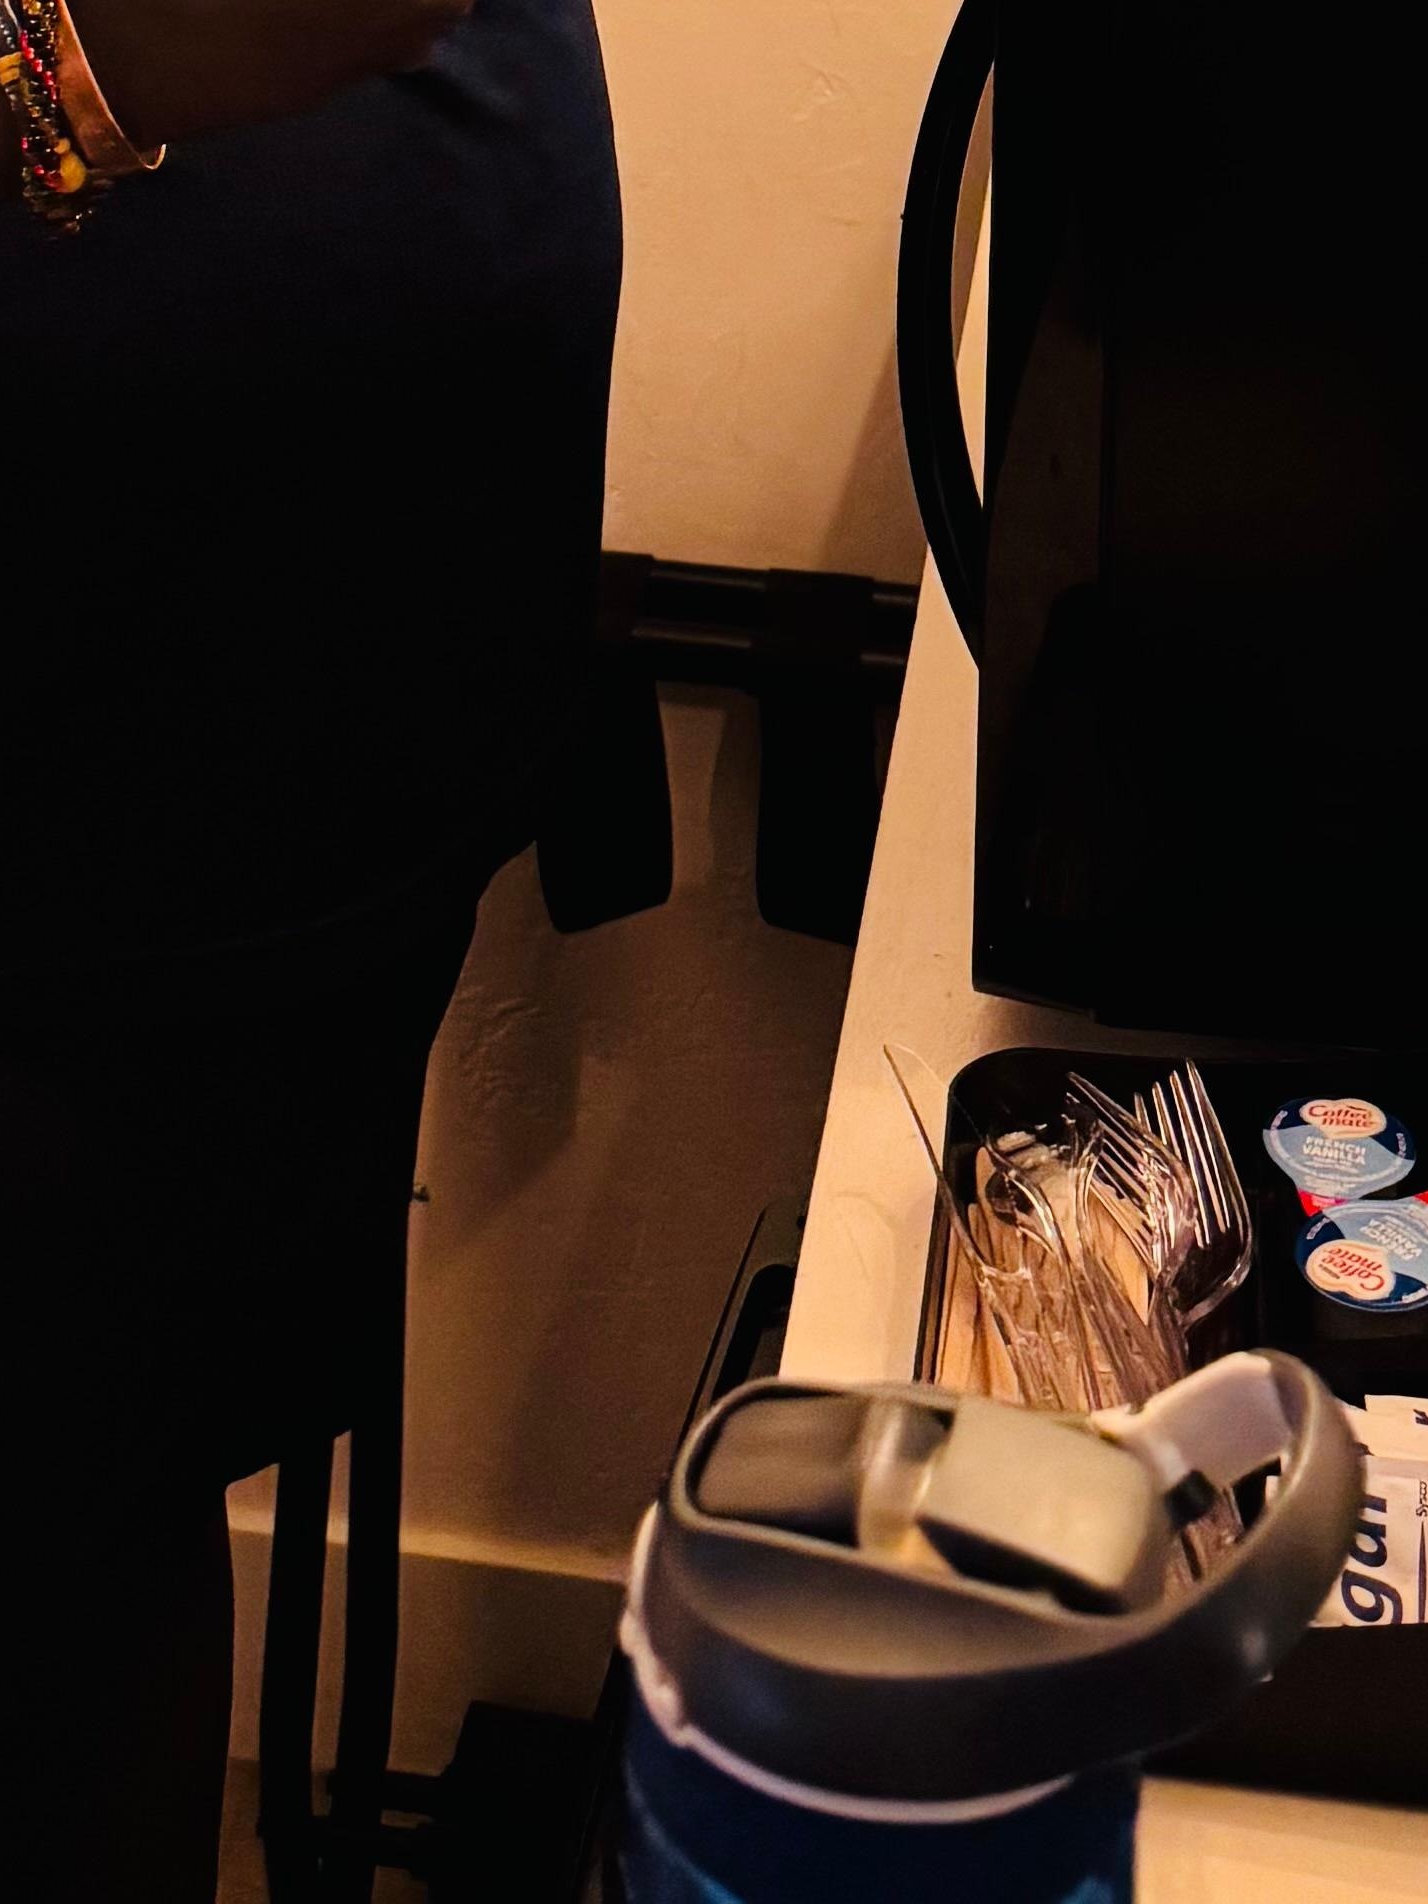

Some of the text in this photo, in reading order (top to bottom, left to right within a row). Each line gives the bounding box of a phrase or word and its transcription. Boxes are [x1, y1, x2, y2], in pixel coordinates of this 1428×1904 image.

[1308, 1104, 1373, 1122] Coffee
[1321, 1115, 1376, 1129] mate
[1302, 1144, 1366, 1165] VANILLA
[1305, 1135, 1366, 1155] FRENCH
[1324, 1247, 1384, 1272] mate
[1321, 1255, 1385, 1293] Coffee
[1415, 1480, 1428, 1518] Sysco
